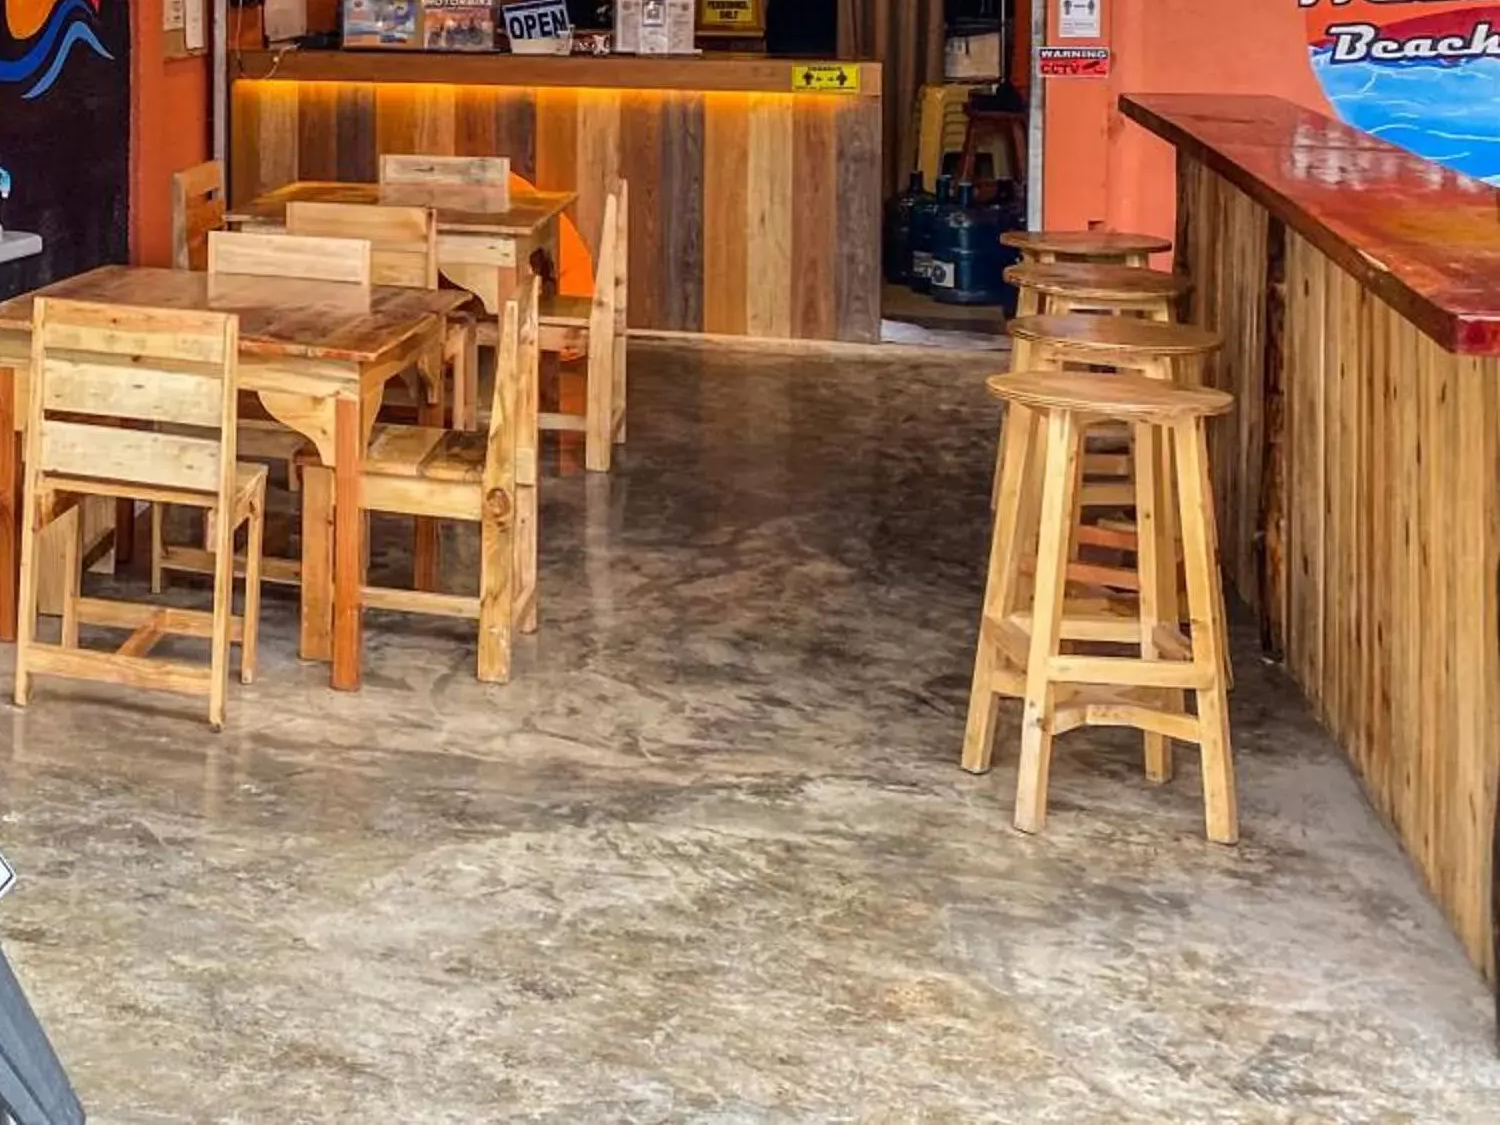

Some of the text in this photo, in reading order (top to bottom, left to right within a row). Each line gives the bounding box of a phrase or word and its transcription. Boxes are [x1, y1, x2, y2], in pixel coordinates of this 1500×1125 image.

[508, 8, 569, 40] OPEN
[1040, 49, 1108, 59] WARNING
[1040, 61, 1081, 75] CCTV
